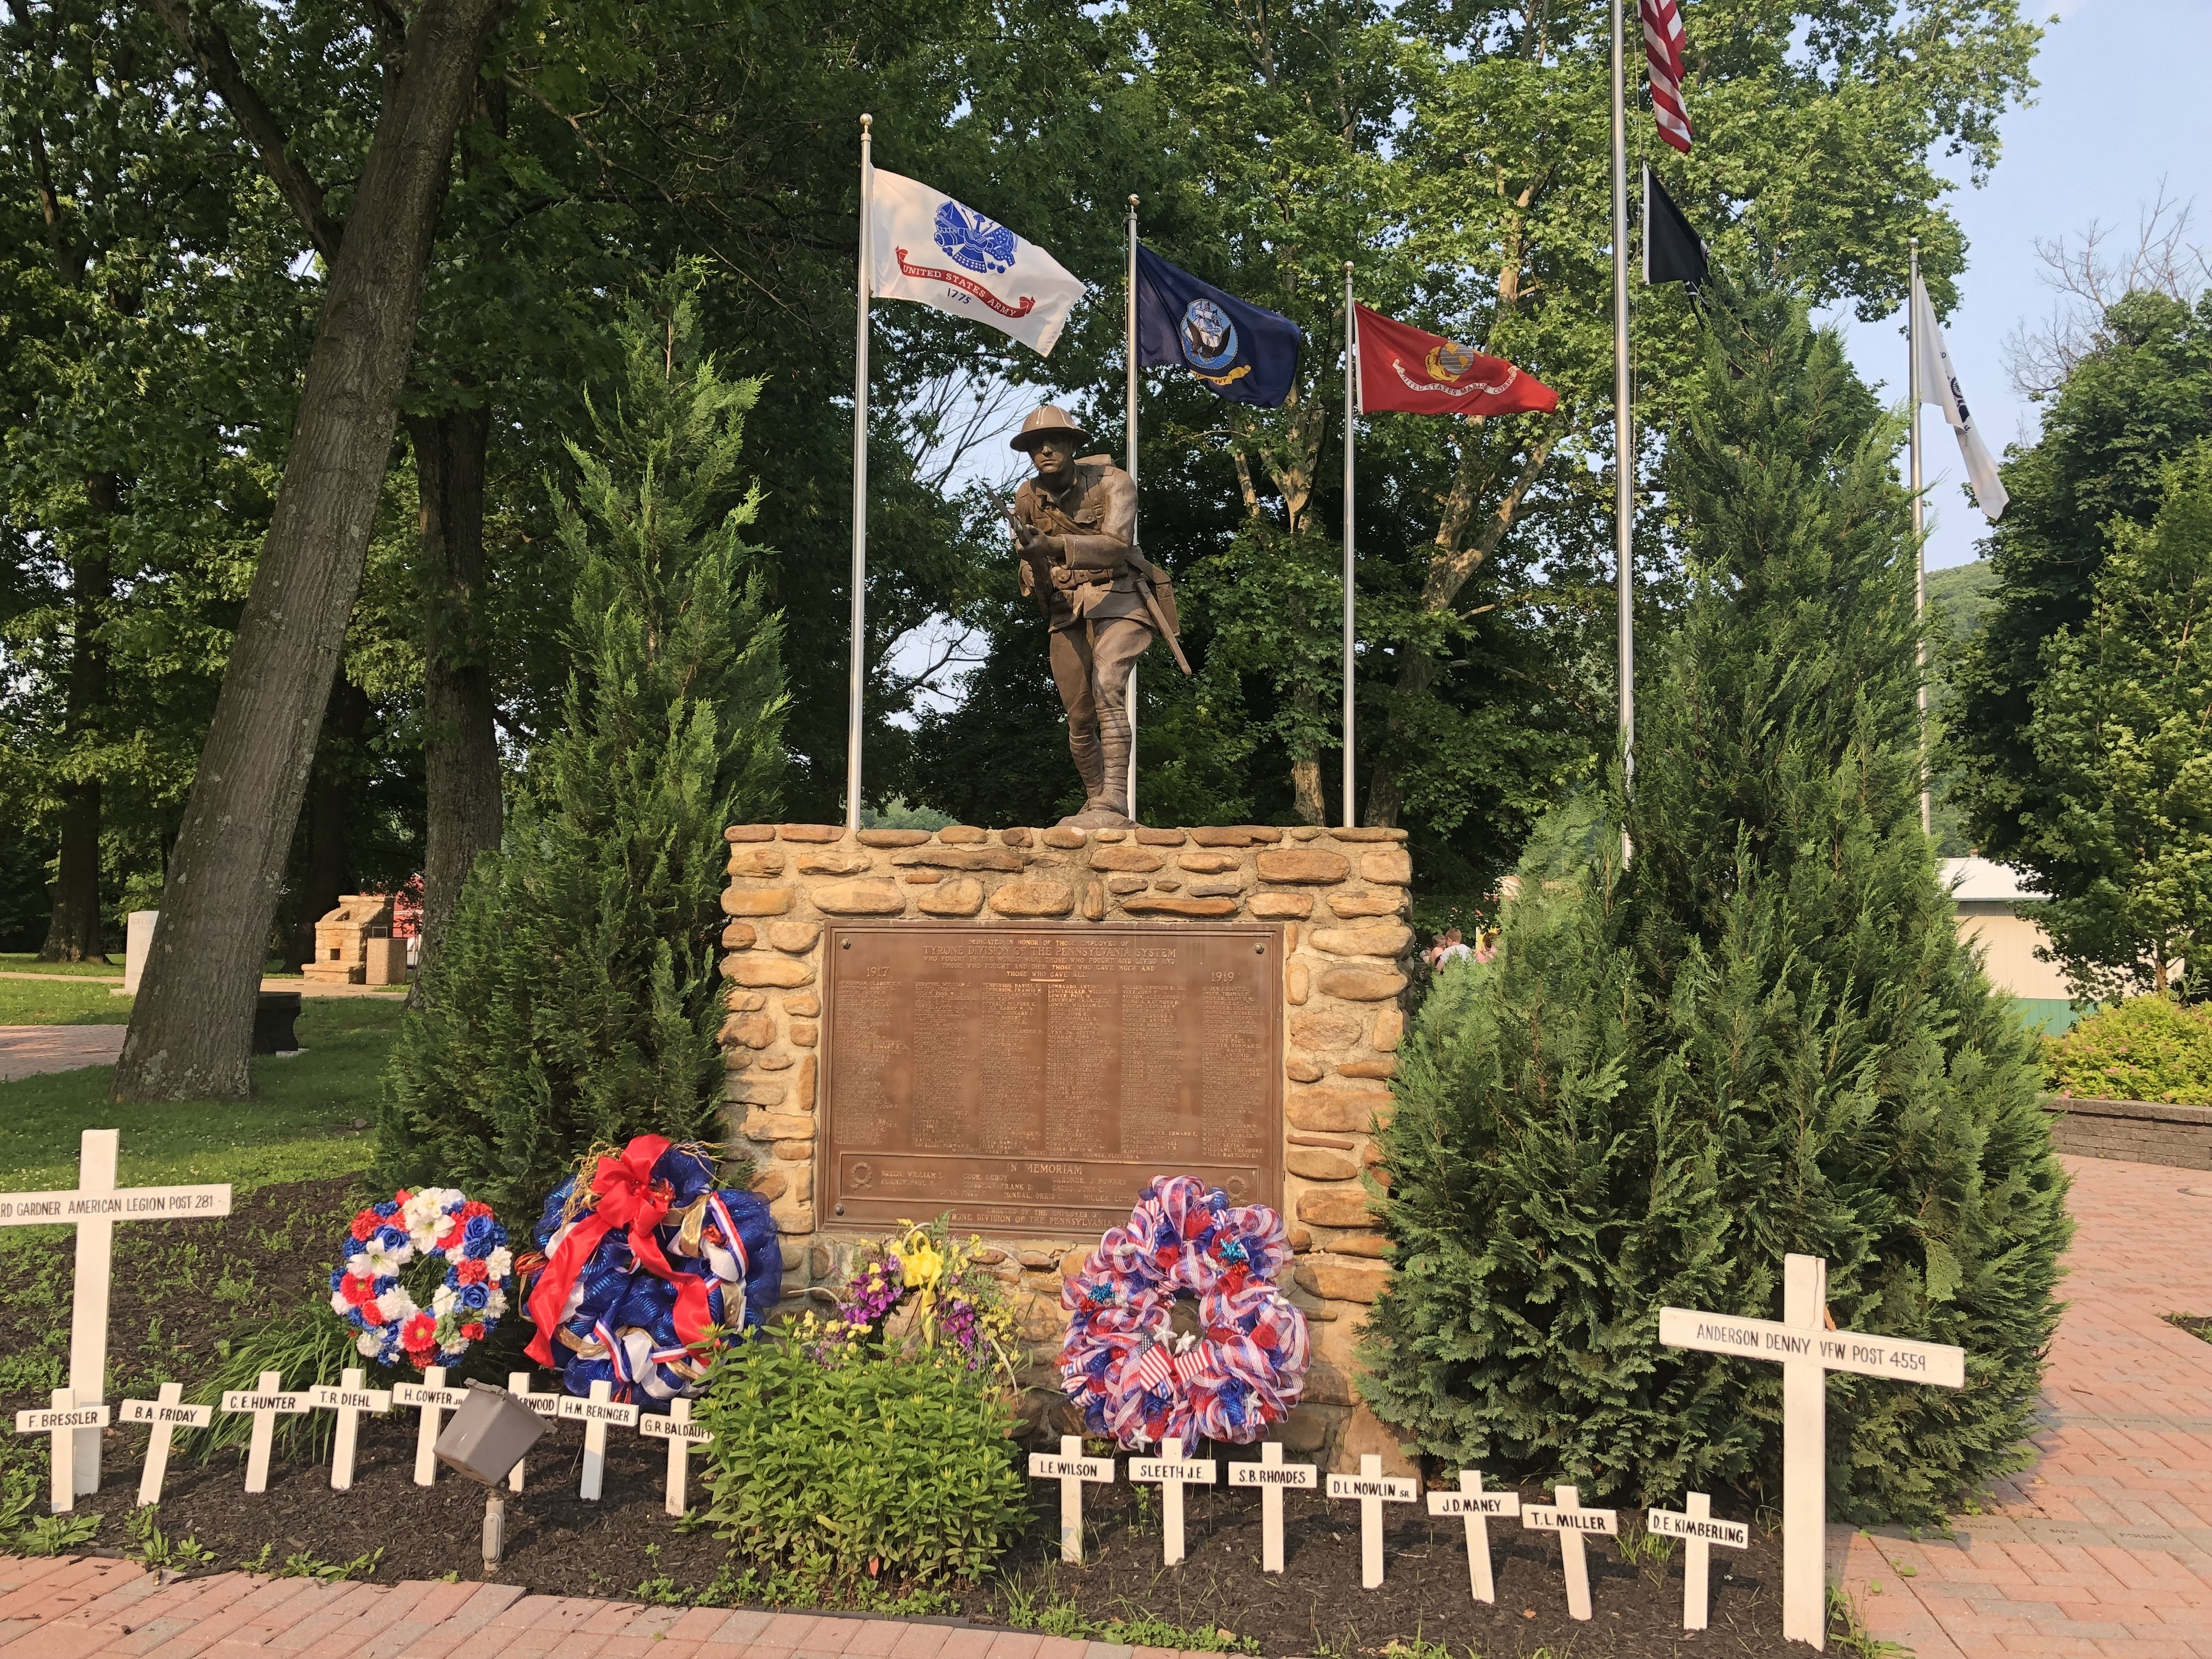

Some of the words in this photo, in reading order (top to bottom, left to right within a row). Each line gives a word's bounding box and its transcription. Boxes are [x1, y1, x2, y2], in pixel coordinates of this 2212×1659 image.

[902, 264, 942, 278] UNITED
[945, 272, 986, 297] STATES
[988, 298, 1017, 317] ARMY
[947, 287, 971, 304] 1775
[1400, 371, 1424, 391] UNITED
[1425, 384, 1457, 395] STATES
[1460, 383, 1489, 394] MARINE
[1493, 375, 1514, 394] CORPS
[923, 945, 964, 955] TYRONE
[968, 946, 1009, 956] DIVISION
[1015, 947, 1026, 956] OF
[1031, 947, 1052, 956] THE
[1056, 947, 1131, 957] PENNSYLVANIA
[1136, 948, 1176, 958] SYSTEM
[867, 967, 890, 977] 1917
[1211, 972, 1234, 982] 1919
[1007, 1163, 1018, 1172] IN
[1025, 1164, 1082, 1175] MEMORIAM
[0, 1201, 12, 1217] RD
[16, 1200, 61, 1217] GARDNER
[68, 1198, 122, 1214] AMERICAN
[127, 1197, 165, 1213] LEGION
[170, 1195, 192, 1210] POST
[195, 1194, 213, 1210] 281
[977, 1215, 1011, 1223] DIVISION
[1049, 1217, 1111, 1226] PENNSYLVANIA
[1697, 1323, 1758, 1347] ANDERSON
[1766, 1333, 1810, 1355] DENNY
[1820, 1341, 1846, 1361] VFW
[1853, 1345, 1884, 1365] POST
[1889, 1352, 1926, 1372] 4559
[251, 1396, 296, 1409] HUNTER
[342, 1393, 371, 1407] DIEHL
[416, 1390, 452, 1404] COWFER
[520, 1397, 554, 1411] RWOOD
[42, 1412, 98, 1427] BRESSLER
[159, 1408, 198, 1423] FRIDAY
[586, 1408, 629, 1422] BERINGER
[1058, 1463, 1097, 1477] WILSON
[1141, 1465, 1183, 1479] SLEETH
[1259, 1470, 1306, 1484] RHOADES
[1354, 1482, 1396, 1497] NOWLIN
[1463, 1499, 1500, 1513] MANEY
[1556, 1514, 1606, 1531] MILLER
[1675, 1519, 1744, 1543] KIMBERLING
